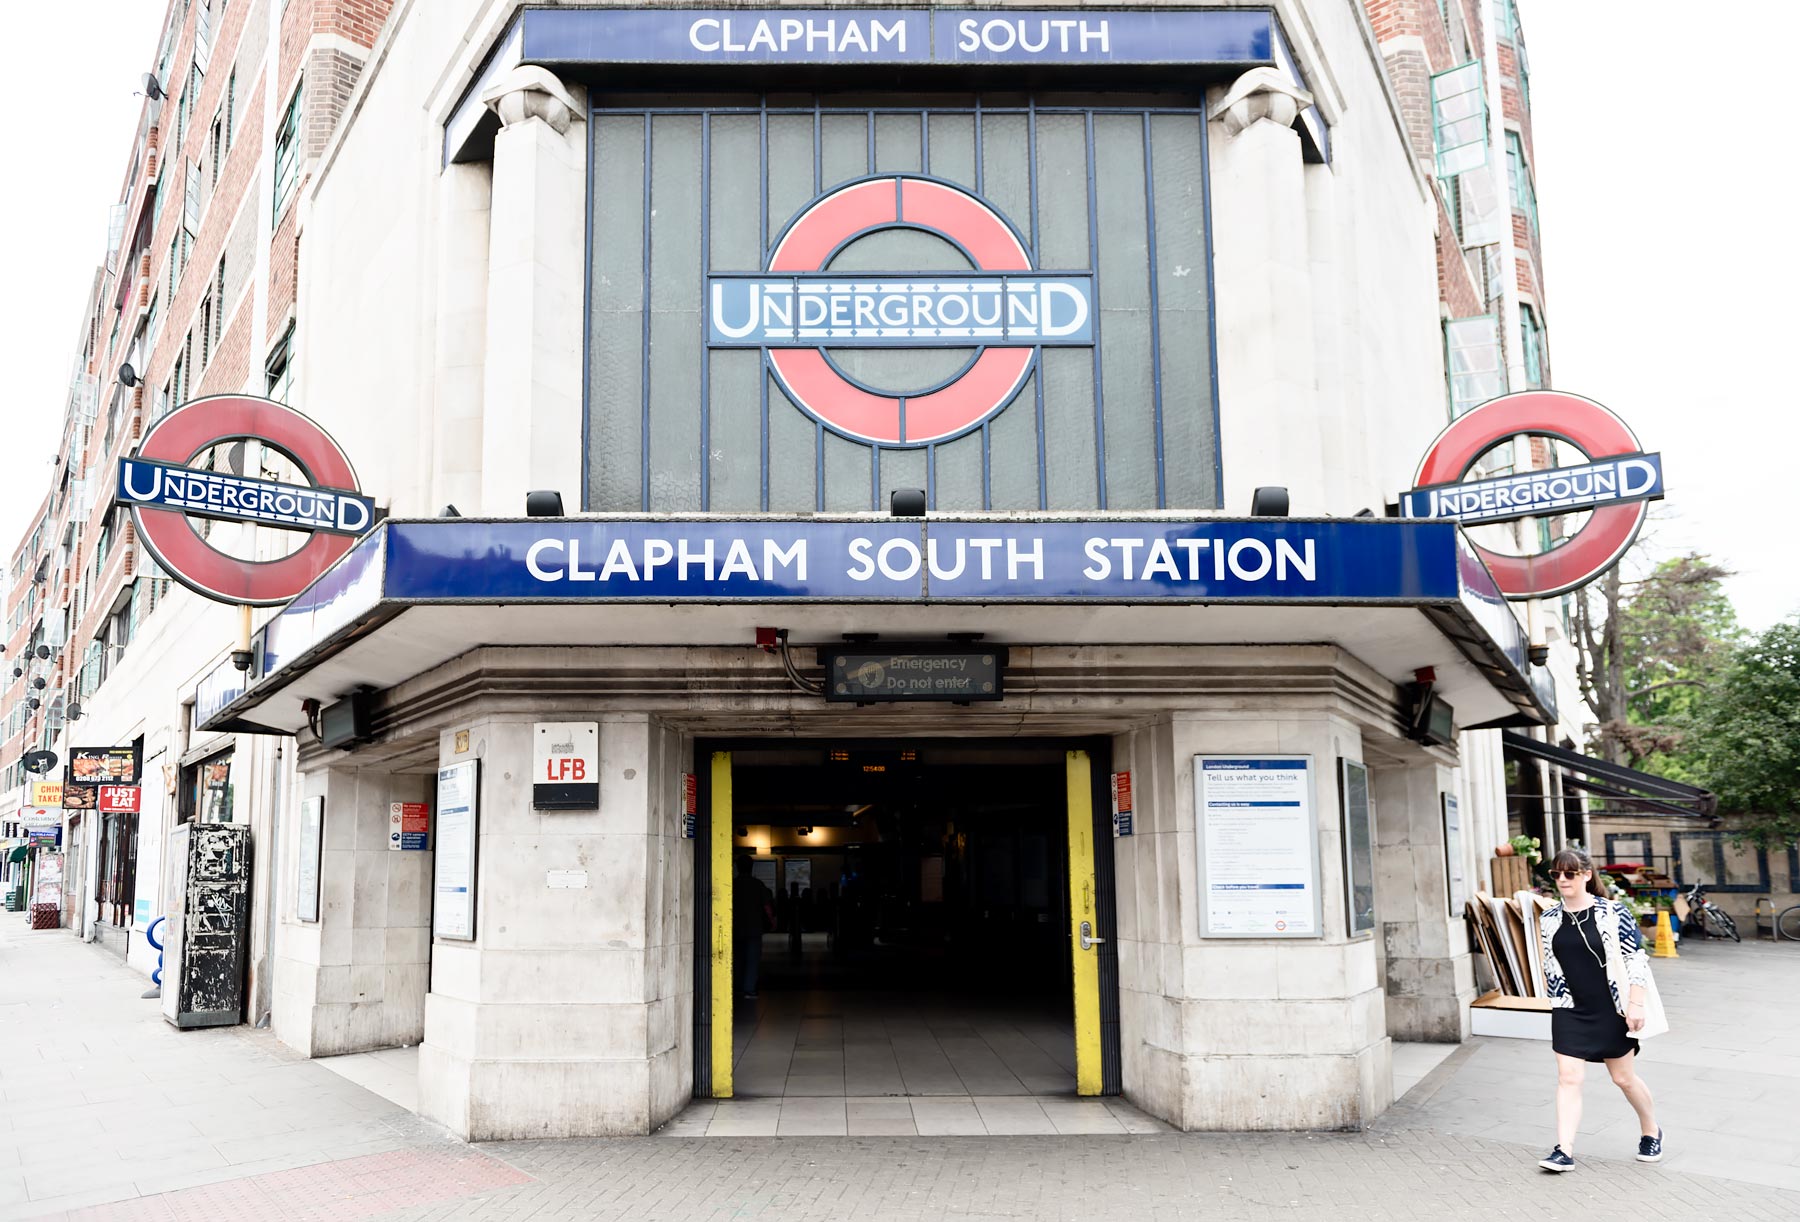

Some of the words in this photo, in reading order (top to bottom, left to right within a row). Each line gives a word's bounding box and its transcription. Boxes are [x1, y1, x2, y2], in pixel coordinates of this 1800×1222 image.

[689, 18, 907, 52] CLAPHAM
[959, 19, 1110, 52] SOUTH
[713, 283, 1088, 338] UNDERGROUND
[124, 462, 369, 531] UNDERGROUND
[1404, 460, 1657, 518] UNDERGROUND
[526, 538, 807, 581] CLAPHAM
[846, 537, 1044, 581] SOUTH
[1083, 537, 1316, 581] STATION
[890, 657, 967, 672] Emergency
[887, 677, 906, 689] Do
[910, 677, 932, 689] not
[935, 677, 971, 689] enter
[547, 758, 585, 780] LFB
[105, 788, 136, 797] JUST
[112, 798, 135, 807] EAT
